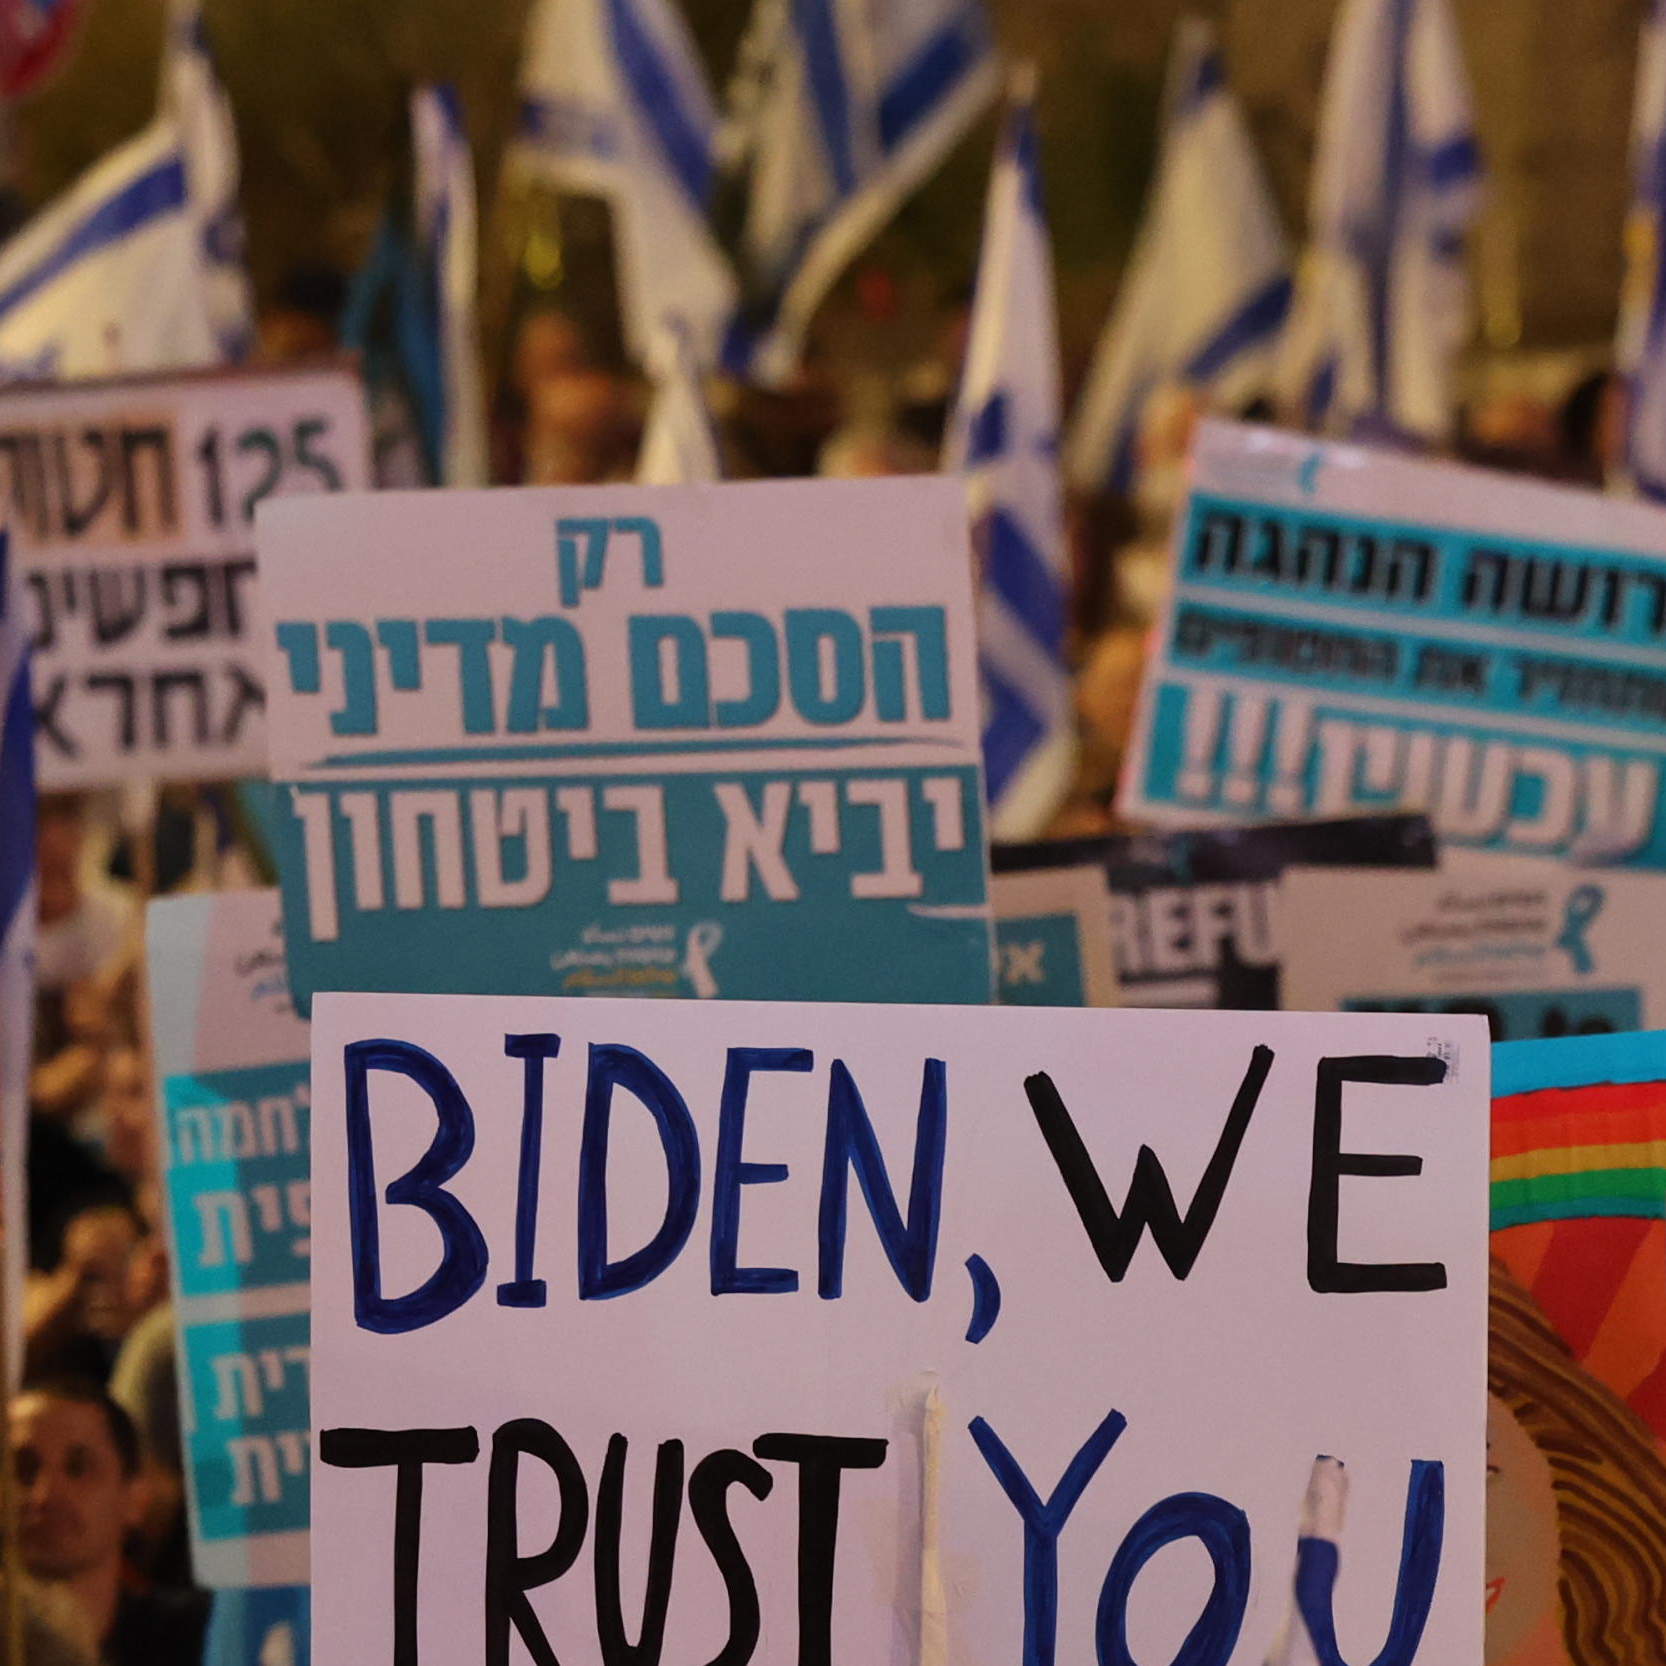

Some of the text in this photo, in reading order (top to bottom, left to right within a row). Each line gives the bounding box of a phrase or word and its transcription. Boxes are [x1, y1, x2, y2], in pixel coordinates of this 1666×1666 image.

[556, 516, 664, 607] רק
[275, 605, 952, 735] הסכם מדיני
[291, 776, 965, 942] יביא ביטחון
[343, 1033, 1448, 1345] BIDEN, WE
